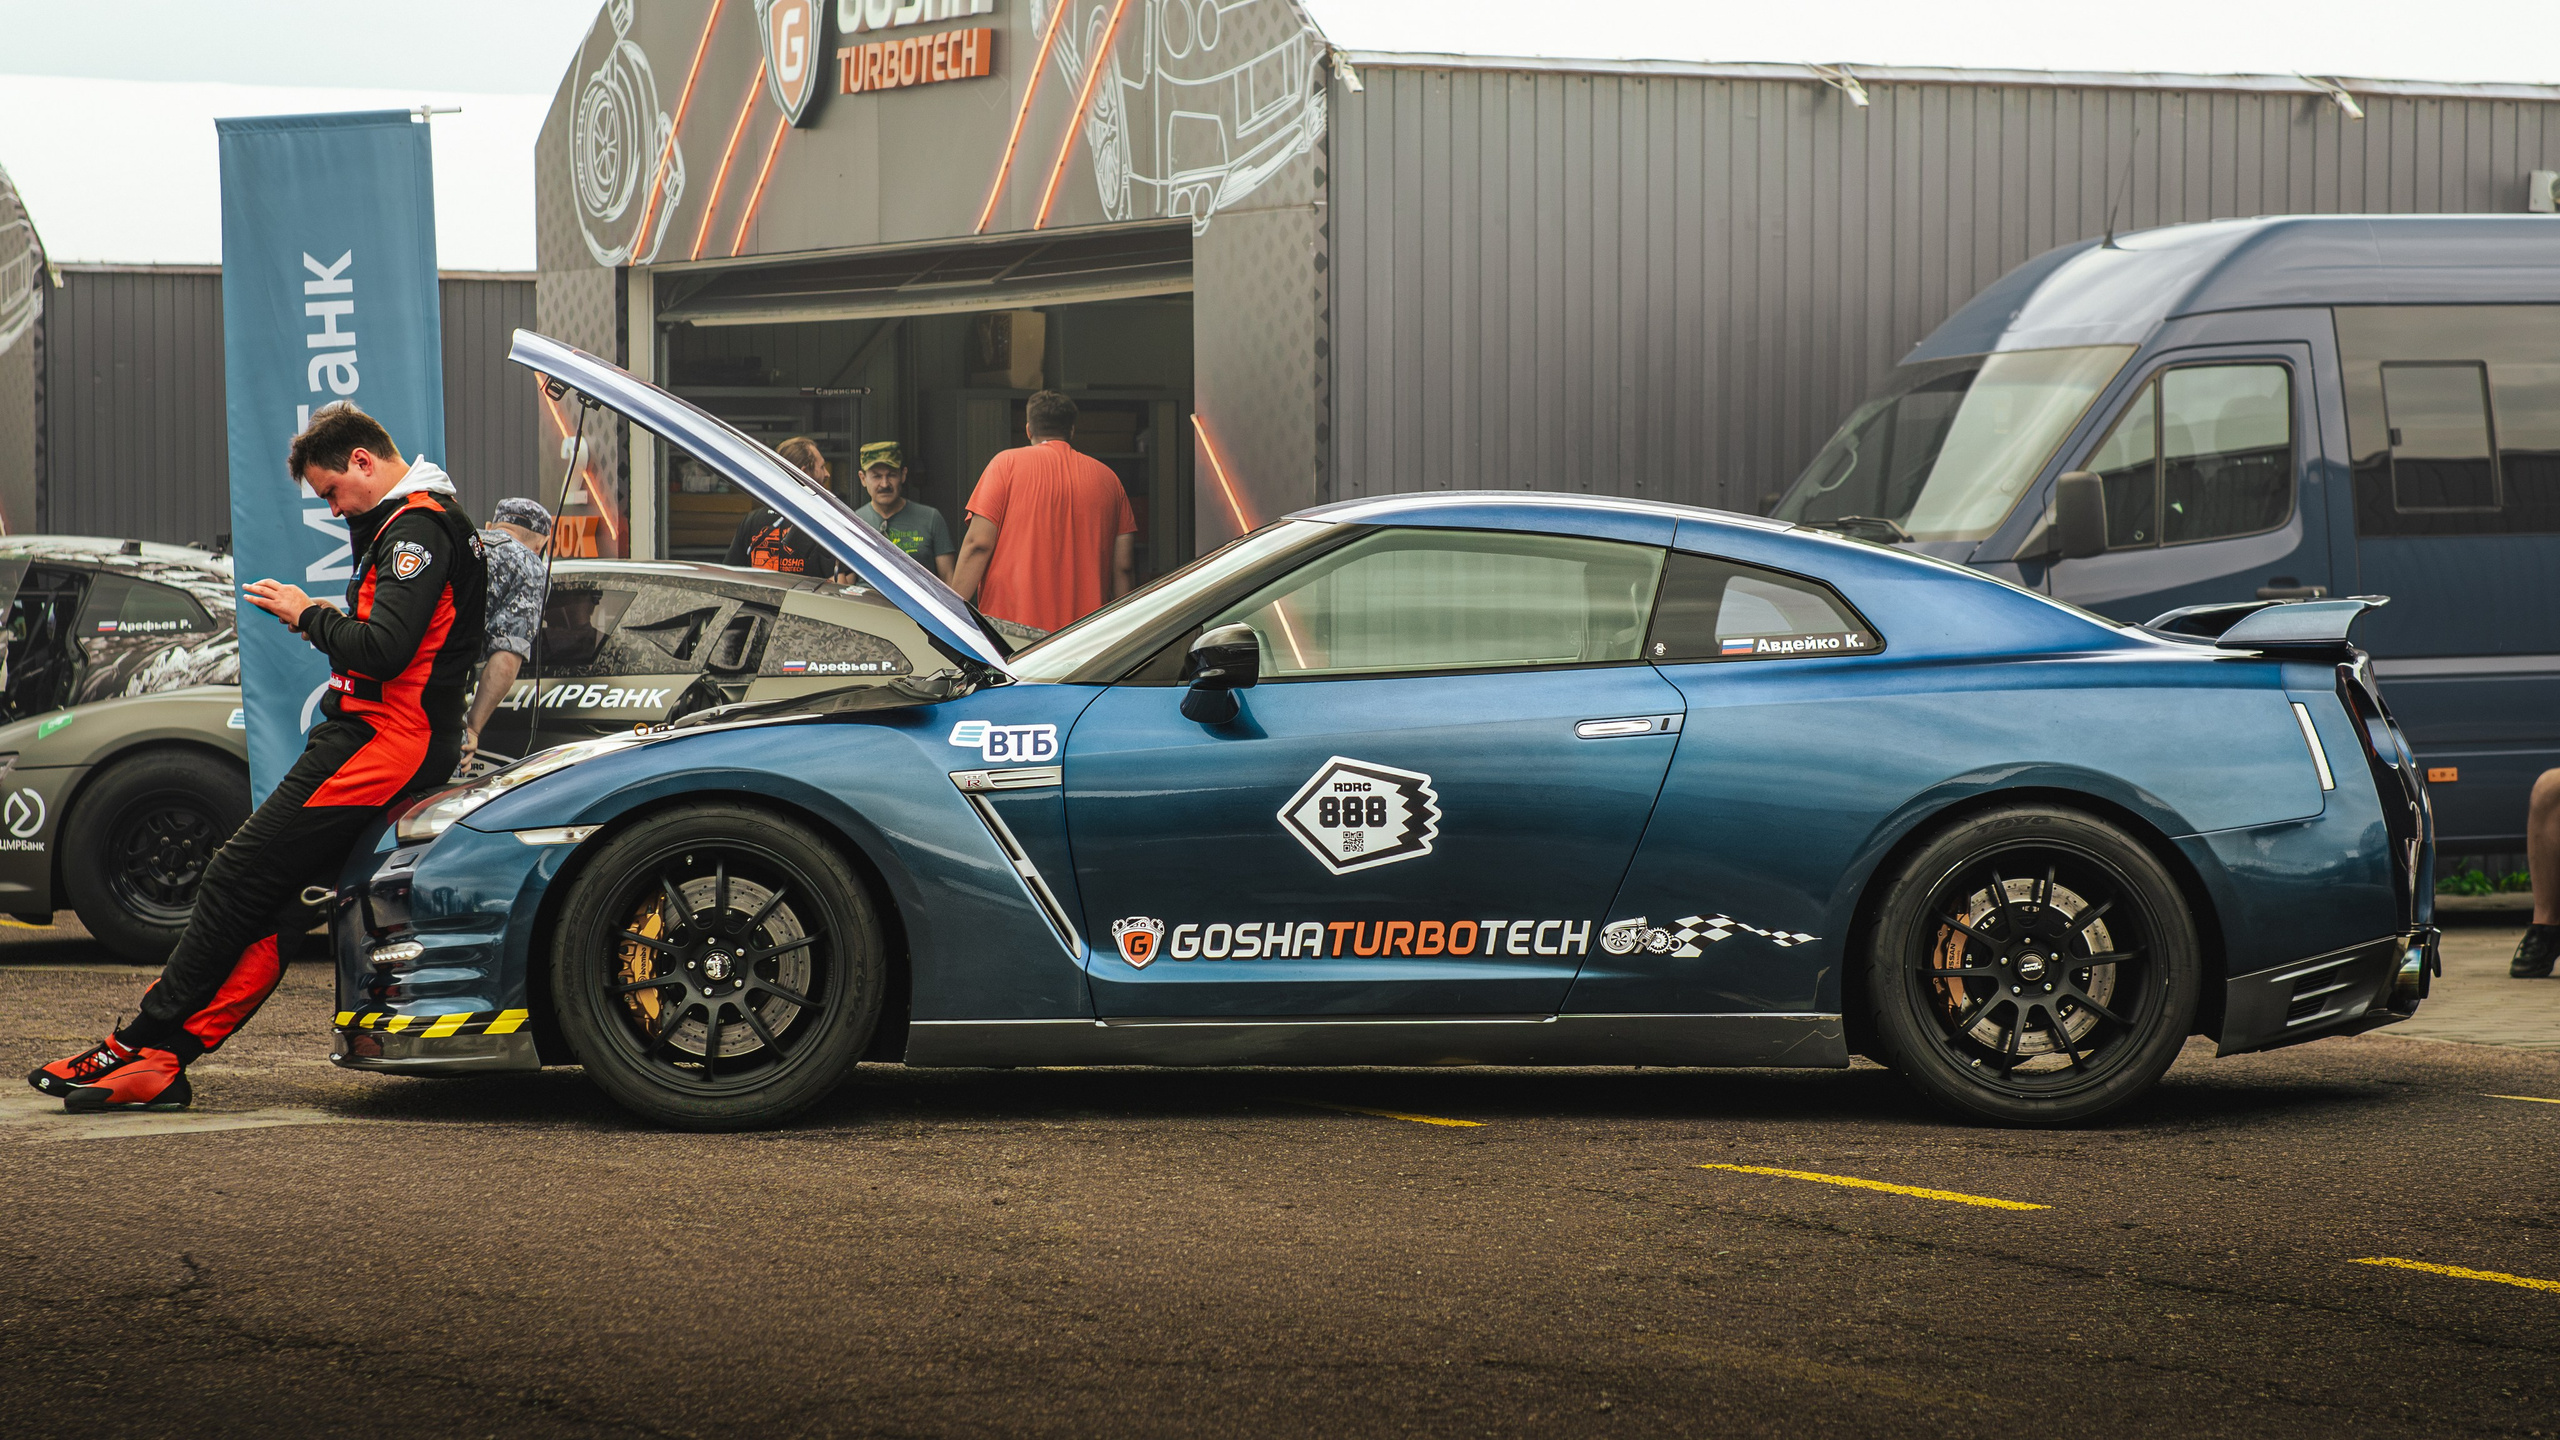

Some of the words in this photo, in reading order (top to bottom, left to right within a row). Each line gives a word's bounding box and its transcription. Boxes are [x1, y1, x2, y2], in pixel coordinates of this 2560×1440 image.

[779, 7, 804, 82] G
[836, 28, 978, 95] TURBOTECH
[560, 435, 589, 505] 2
[400, 555, 416, 572] G
[1756, 635, 1840, 654] Авдейко
[1844, 634, 1865, 648] К.
[807, 661, 878, 673] Арефьев
[881, 661, 896, 671] Р.
[989, 729, 1053, 757] ВТБ
[1333, 782, 1372, 793] RDRC
[1318, 795, 1388, 829] 888
[1131, 935, 1148, 956] G
[1170, 920, 1592, 959] GOSHATURBOTECH
